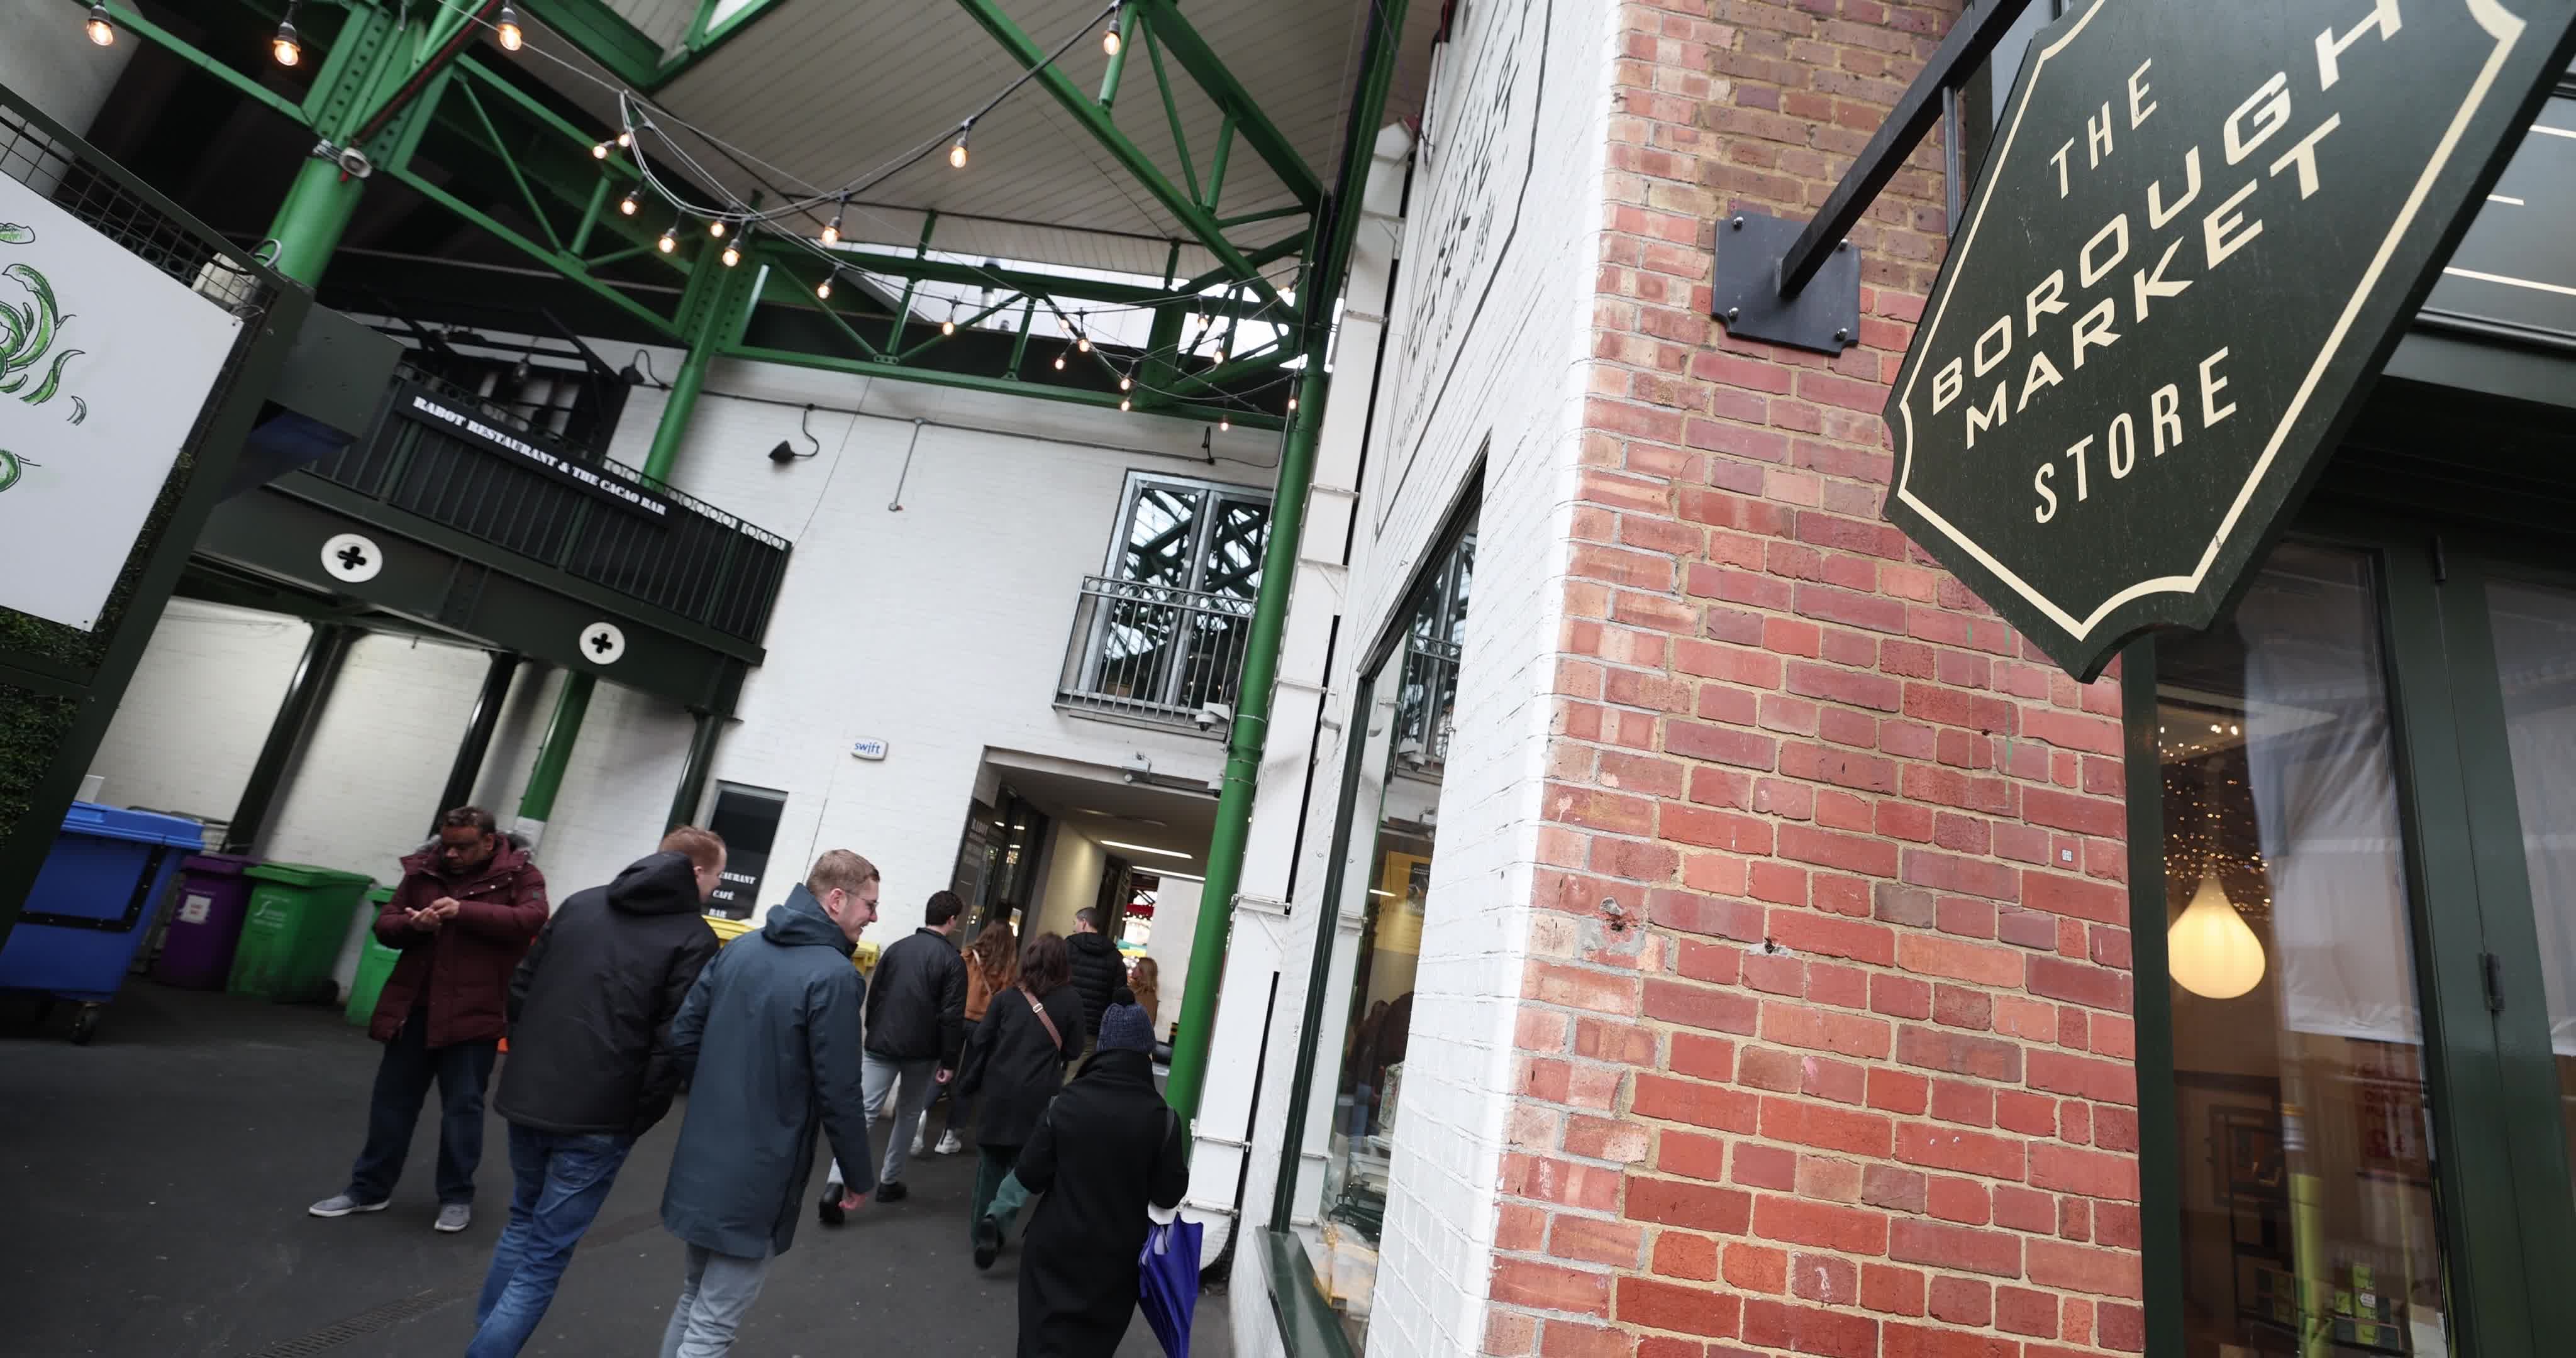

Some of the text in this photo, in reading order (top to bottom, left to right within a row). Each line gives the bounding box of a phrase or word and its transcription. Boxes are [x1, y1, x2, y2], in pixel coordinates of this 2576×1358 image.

[1933, 0, 2403, 416] BOROUGH
[2050, 57, 2157, 199] THE
[1966, 112, 2341, 450] MARKET
[413, 395, 667, 516] RABOT RESTAURANT & THE CACAO BAR
[2035, 346, 2236, 524] STORE
[855, 742, 880, 754] swift
